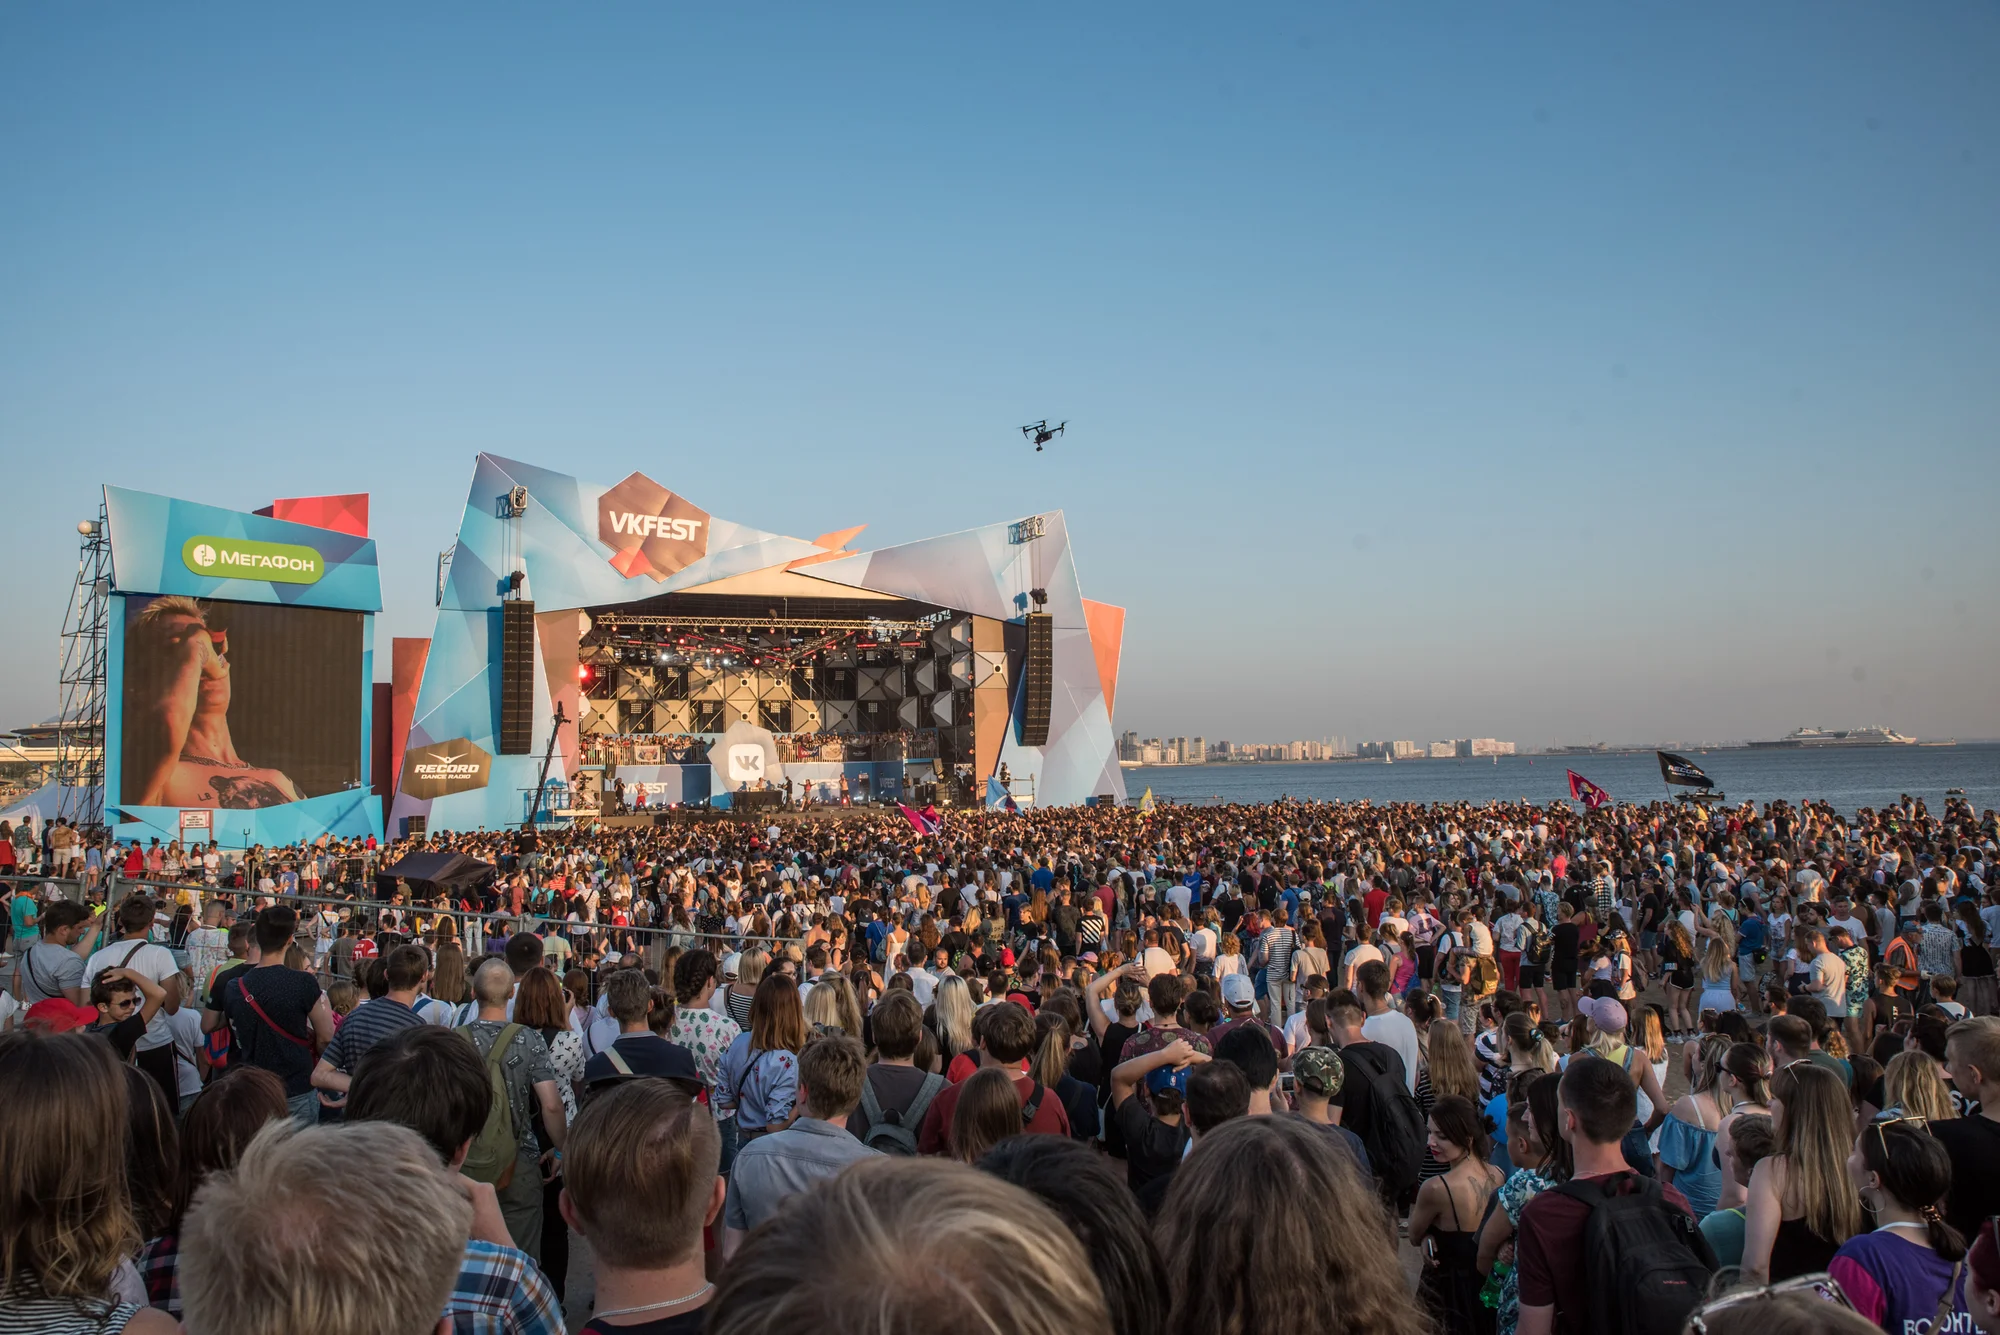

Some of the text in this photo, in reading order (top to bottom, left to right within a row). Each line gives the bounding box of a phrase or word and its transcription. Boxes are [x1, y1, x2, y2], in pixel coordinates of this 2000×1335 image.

[608, 510, 702, 542] VKFEST
[414, 764, 480, 774] RECORD
[735, 755, 760, 771] VK
[623, 782, 668, 794] VKEST
